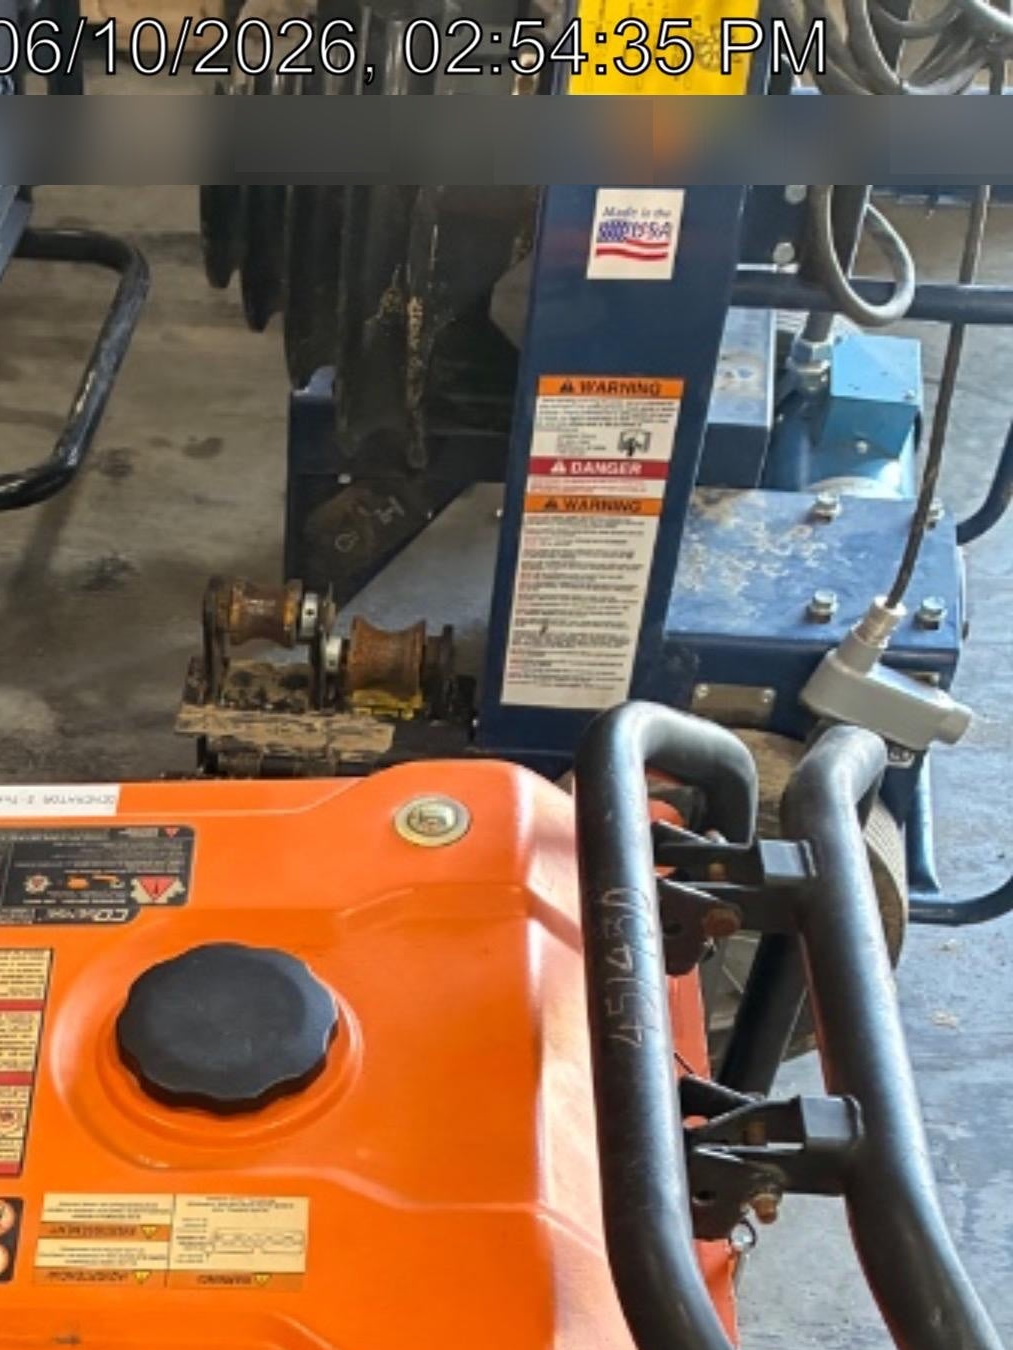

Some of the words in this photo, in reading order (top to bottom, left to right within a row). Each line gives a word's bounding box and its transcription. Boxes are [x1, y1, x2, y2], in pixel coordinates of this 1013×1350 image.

[602, 206, 638, 218] Made
[641, 207, 651, 218] in
[653, 206, 672, 218] the
[580, 380, 662, 397] WARNING
[570, 460, 643, 475] DANGER
[563, 498, 641, 513] WARNING
